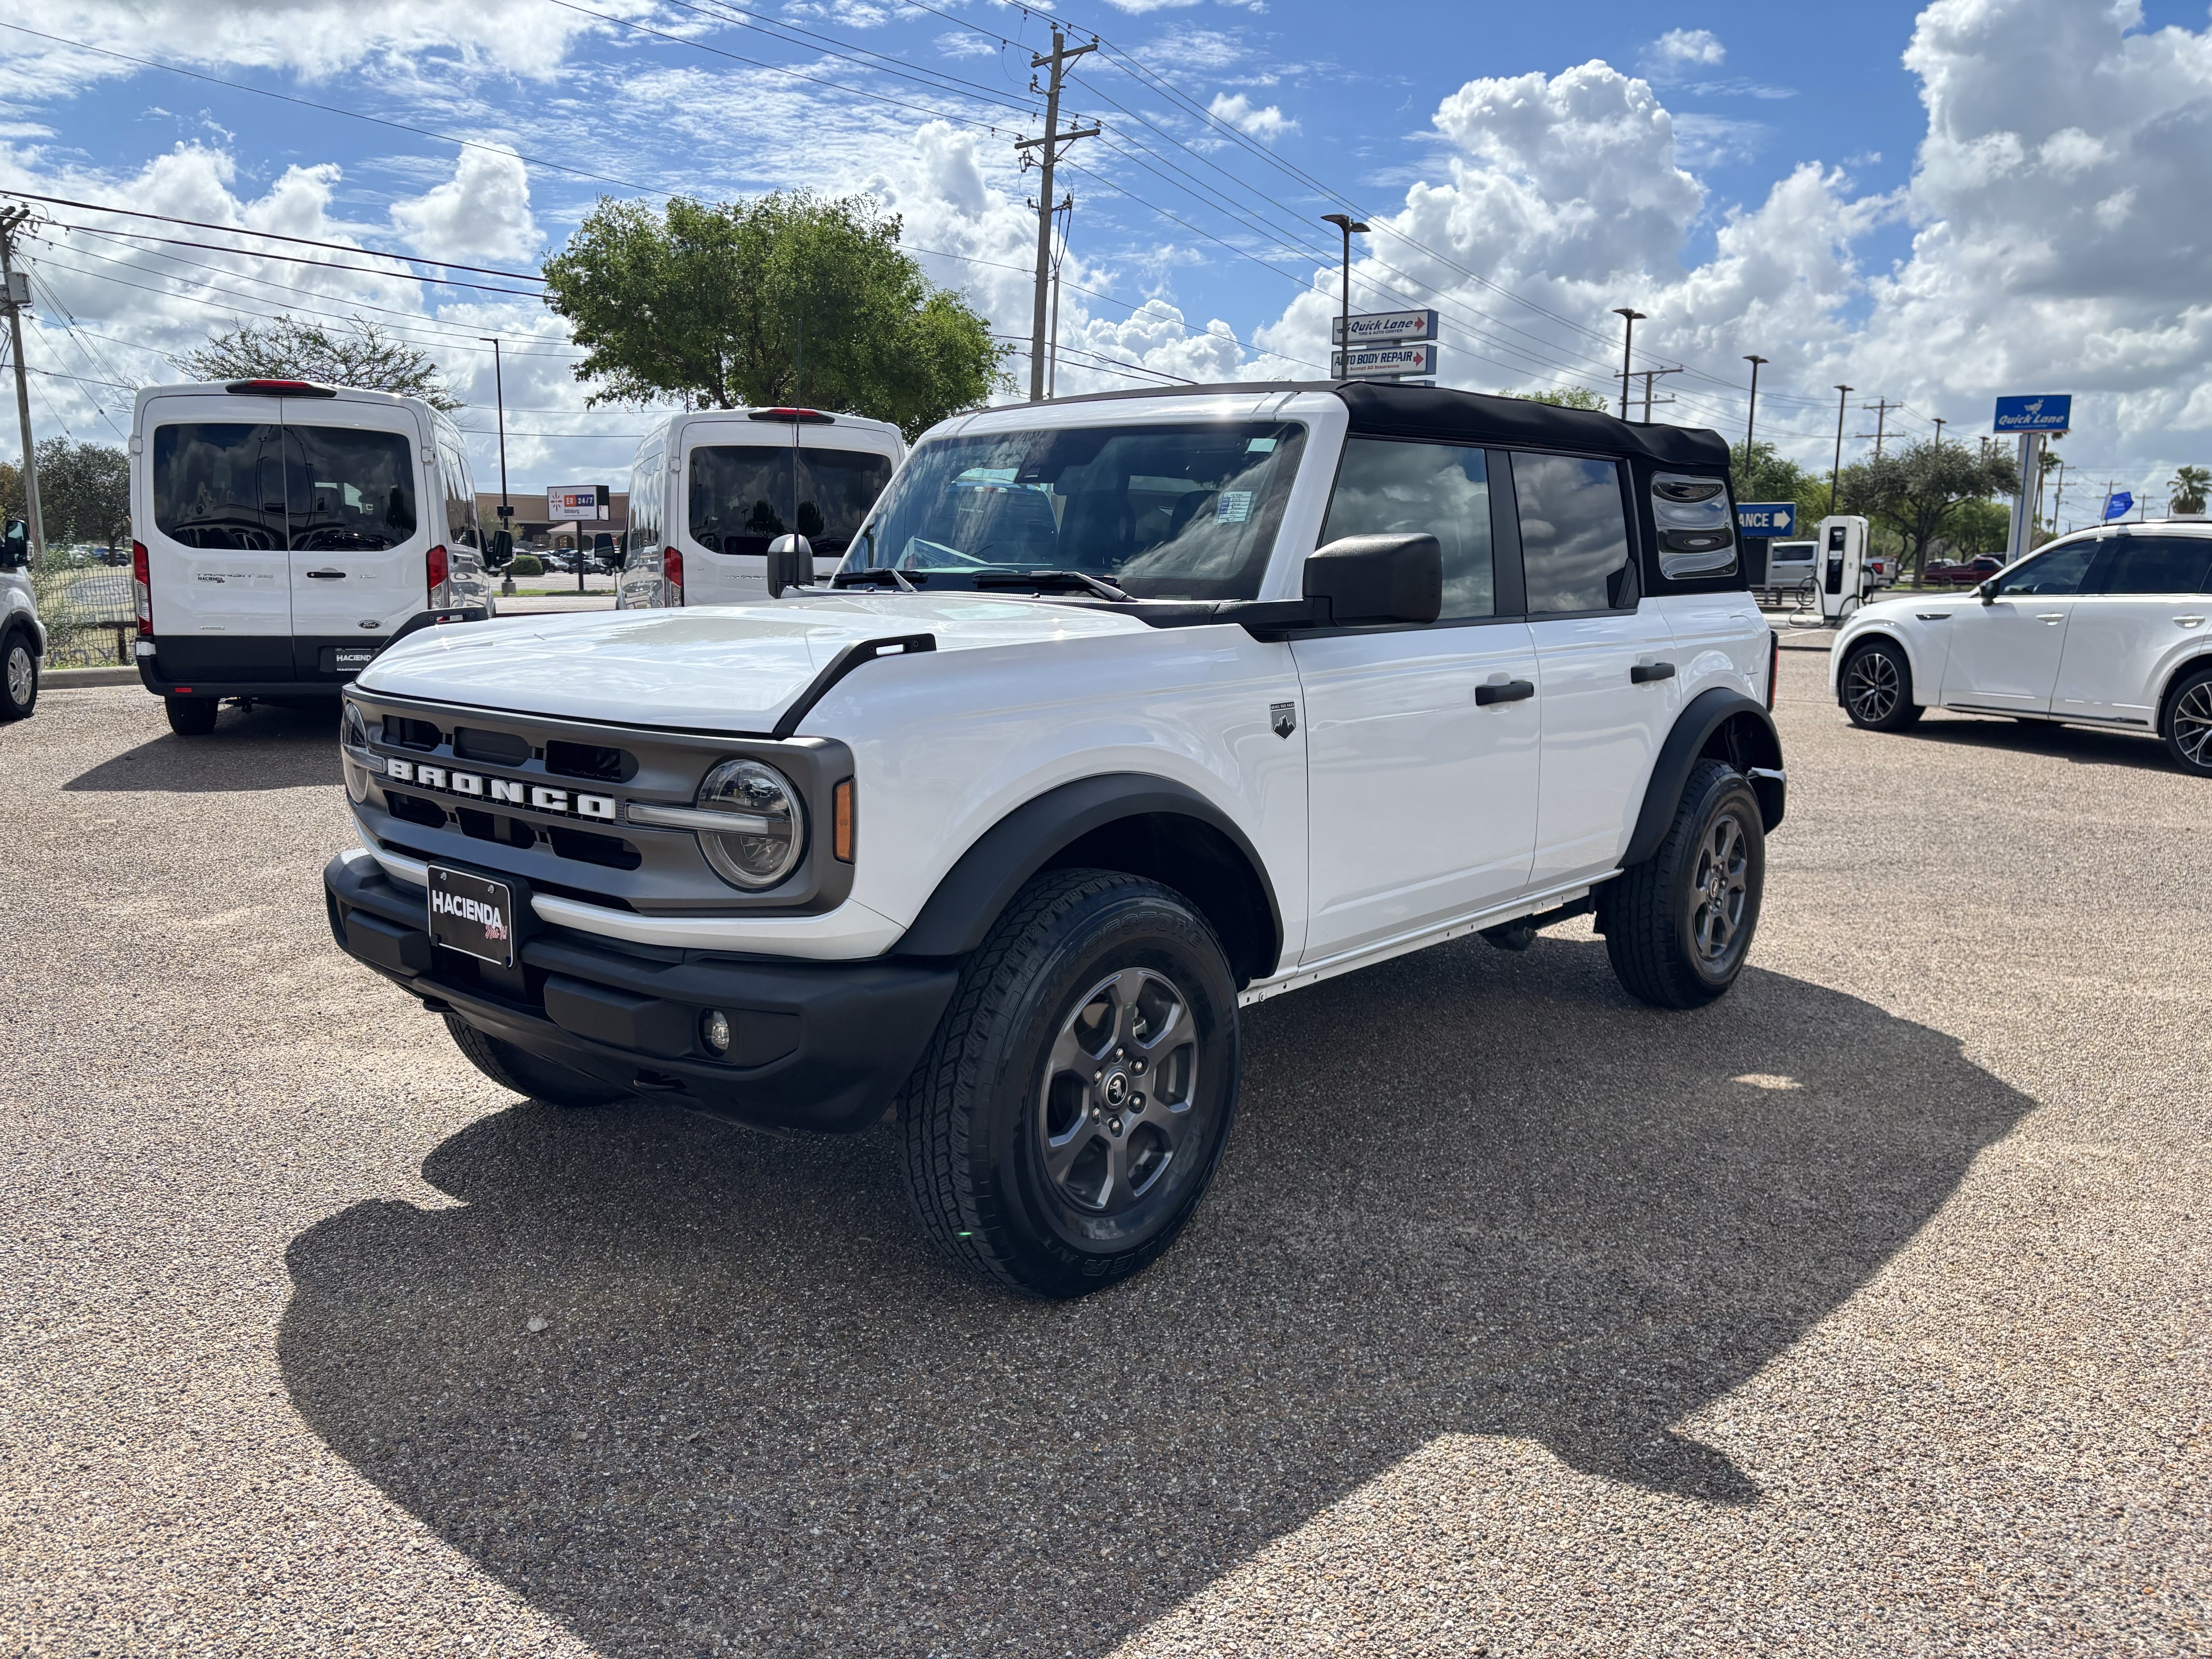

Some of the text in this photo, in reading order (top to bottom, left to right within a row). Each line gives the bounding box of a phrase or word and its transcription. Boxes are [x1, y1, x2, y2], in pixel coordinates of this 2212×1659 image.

[1351, 319, 1413, 333] Quick Lane
[1334, 351, 1413, 366] ATO BODY REPAIR
[1998, 414, 2064, 426] Quick Lane
[1738, 513, 1770, 527] ANCE
[388, 758, 615, 819] BRONCO
[432, 890, 502, 931] HACIENDA
